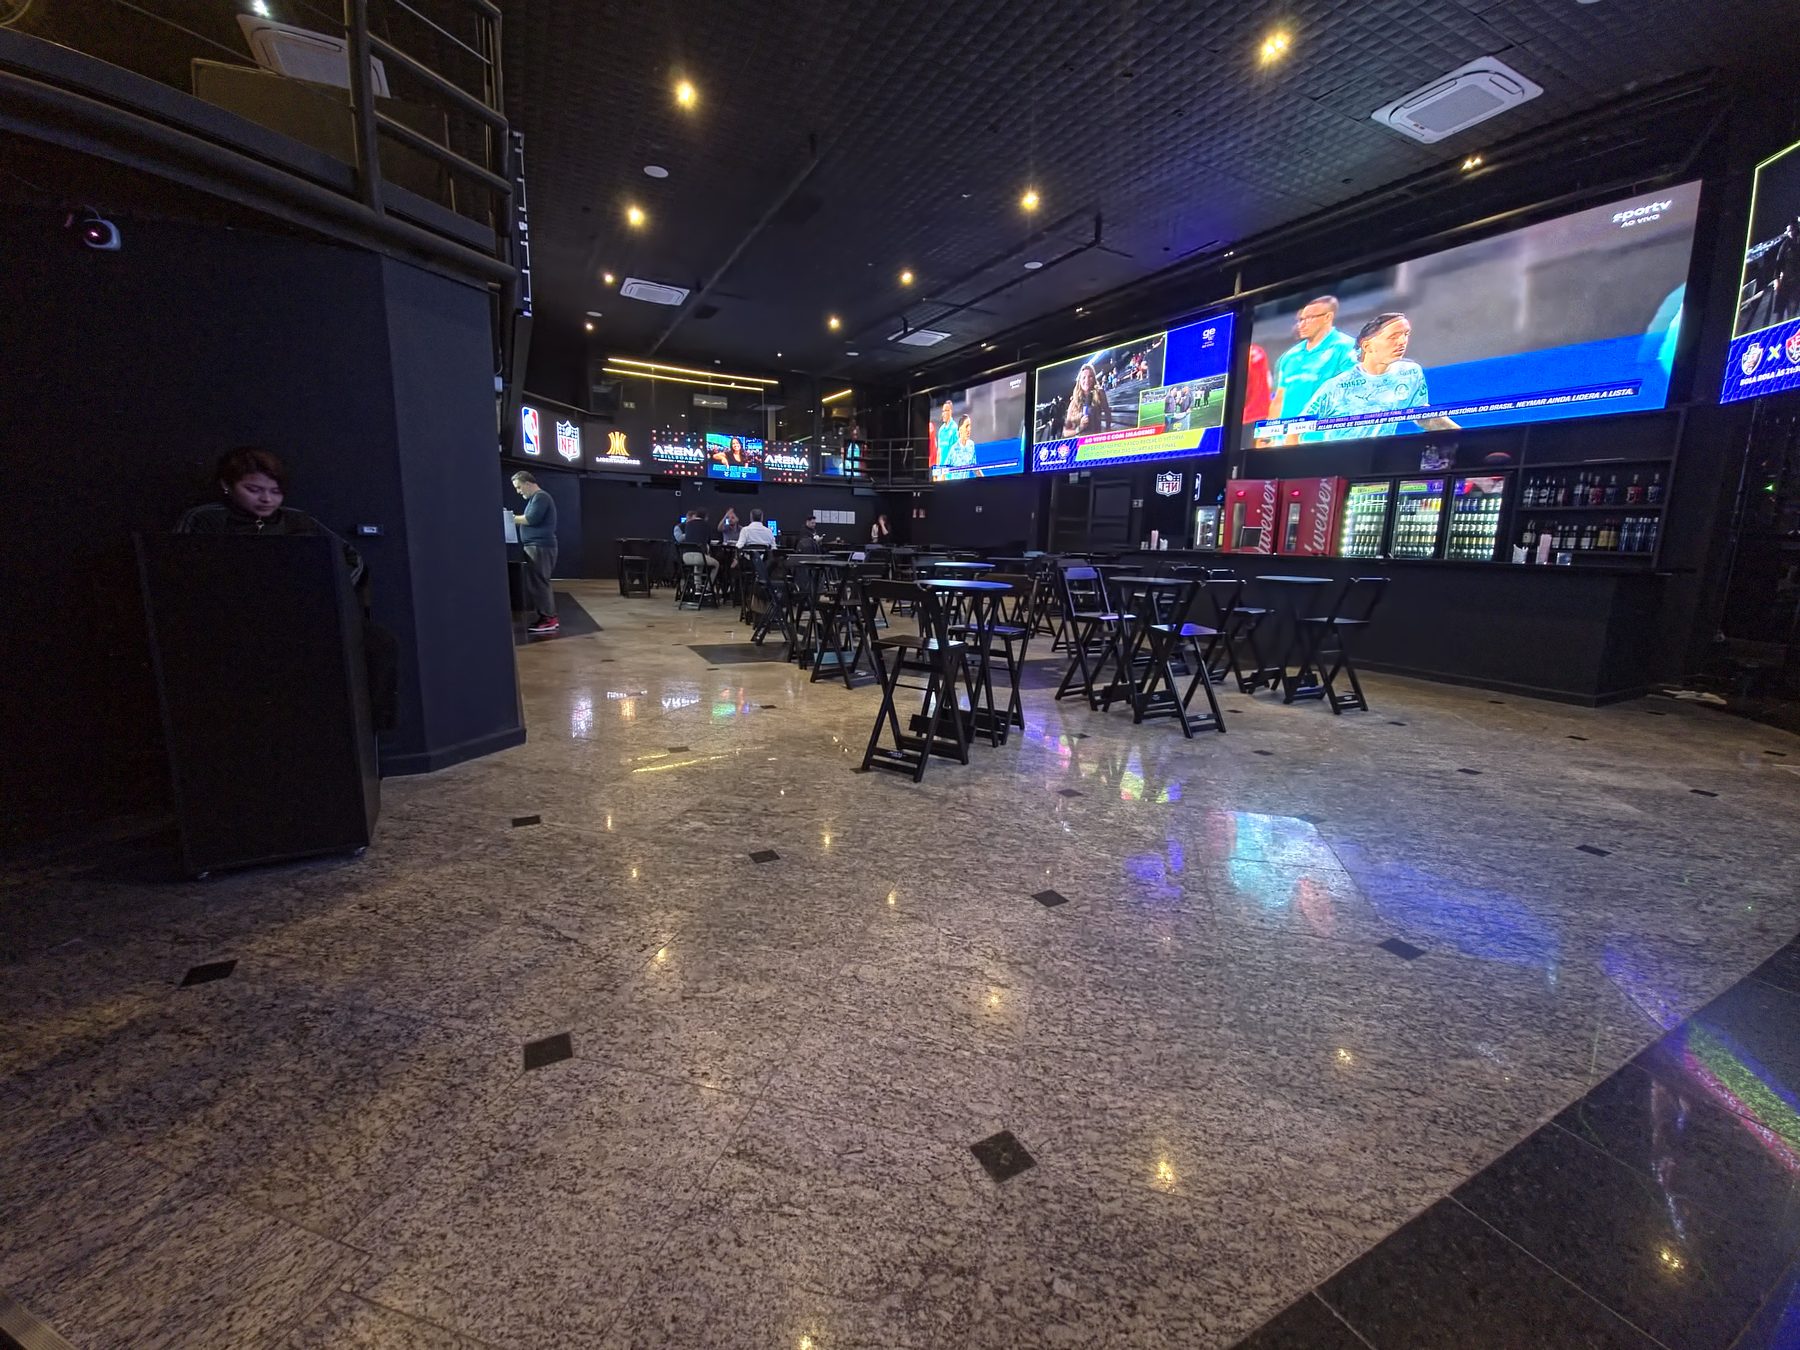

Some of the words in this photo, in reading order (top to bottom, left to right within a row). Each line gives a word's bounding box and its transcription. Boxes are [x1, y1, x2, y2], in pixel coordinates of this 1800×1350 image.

[1612, 199, 1672, 223] sportv
[1620, 219, 1636, 228] AO
[1636, 214, 1660, 224] VIVO
[1388, 415, 1406, 423] VENDA
[1406, 413, 1422, 421] MAIS
[1421, 411, 1438, 419] CARA
[1515, 398, 1547, 408] NEYMAR
[1546, 395, 1572, 405] AINDA
[1571, 391, 1600, 401] LIDERA
[1600, 390, 1609, 398] A
[1608, 387, 1634, 397] LISTA.
[653, 444, 704, 458] ARENA
[764, 454, 809, 466] ARENA
[1257, 480, 1277, 554] weiser
